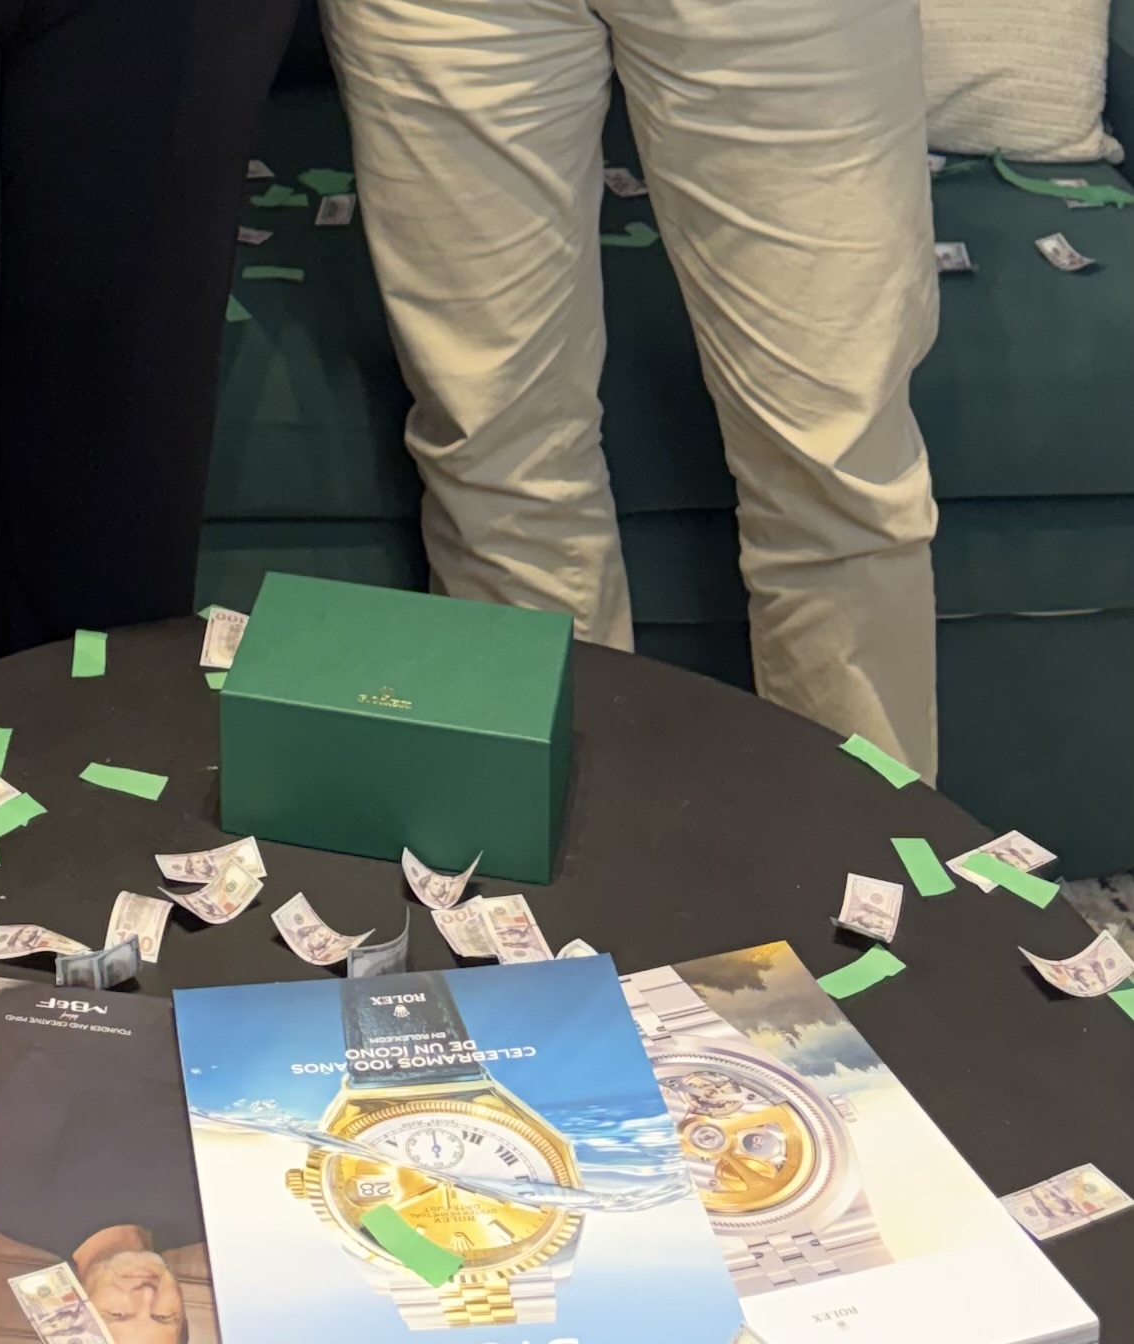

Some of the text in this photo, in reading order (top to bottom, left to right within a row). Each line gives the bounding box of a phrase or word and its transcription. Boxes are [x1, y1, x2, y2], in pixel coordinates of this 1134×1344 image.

[370, 992, 427, 1006] ROLEX
[28, 1016, 68, 1028] CREATIVE
[69, 1022, 89, 1031] AND
[89, 1024, 132, 1036] FOUNDER
[369, 1031, 446, 1044] EN ROLEX.COM
[413, 1042, 444, 1055] UN
[448, 1039, 477, 1052] DE
[290, 1046, 537, 1075] CELEBRAMOS 100 AÑOS
[359, 1181, 392, 1196] 28
[811, 1306, 858, 1323] ROLEX
